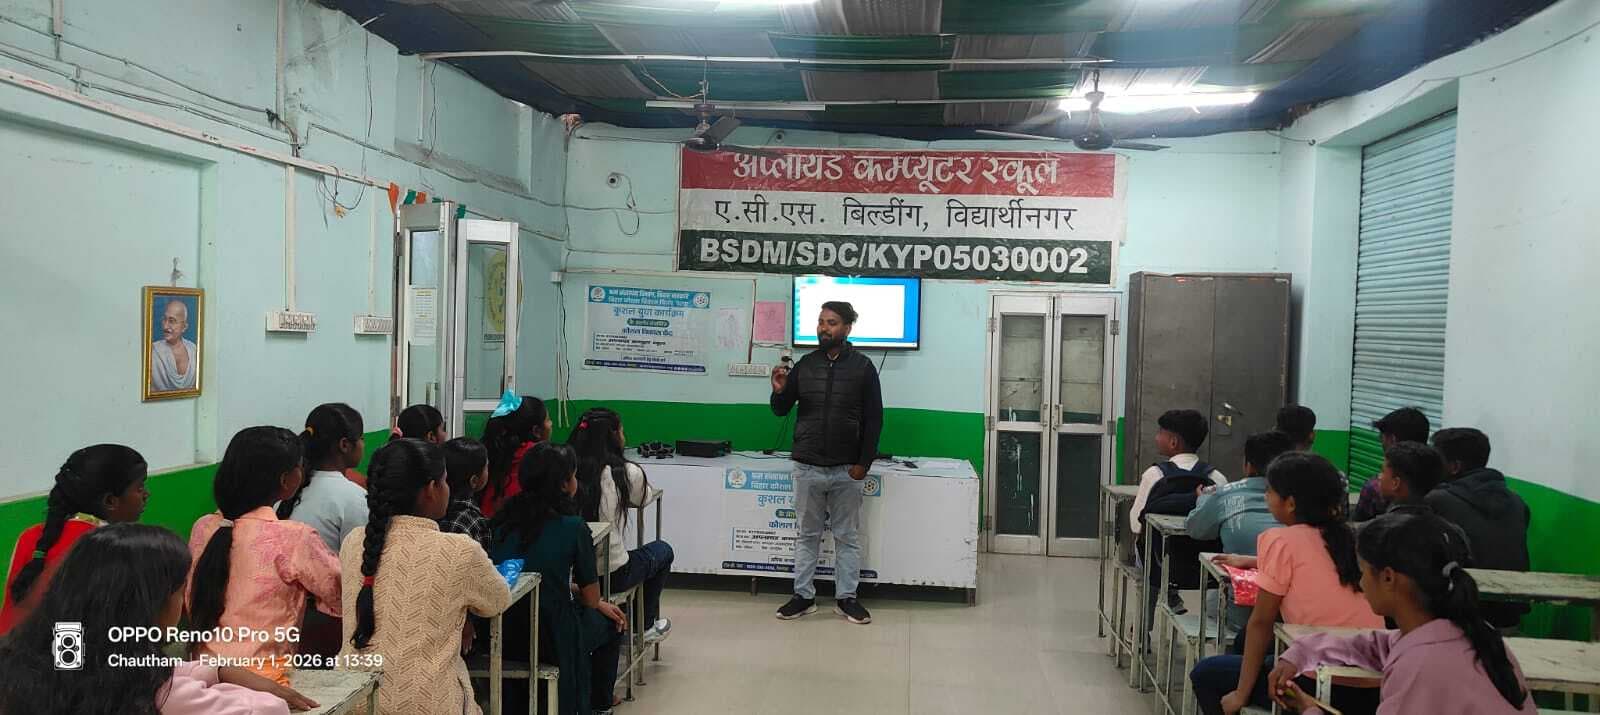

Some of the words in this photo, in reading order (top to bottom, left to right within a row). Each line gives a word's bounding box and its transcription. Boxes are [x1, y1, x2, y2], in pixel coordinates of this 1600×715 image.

[733, 152, 846, 180] अप्लायड
[853, 155, 972, 192] कम्प्यूटर
[980, 157, 1060, 195] स्कूल
[946, 198, 1077, 230] विद्यार्थीनगर
[700, 238, 1088, 274] BSDM/SDC/KYP05030002
[757, 494, 786, 506] कुशल
